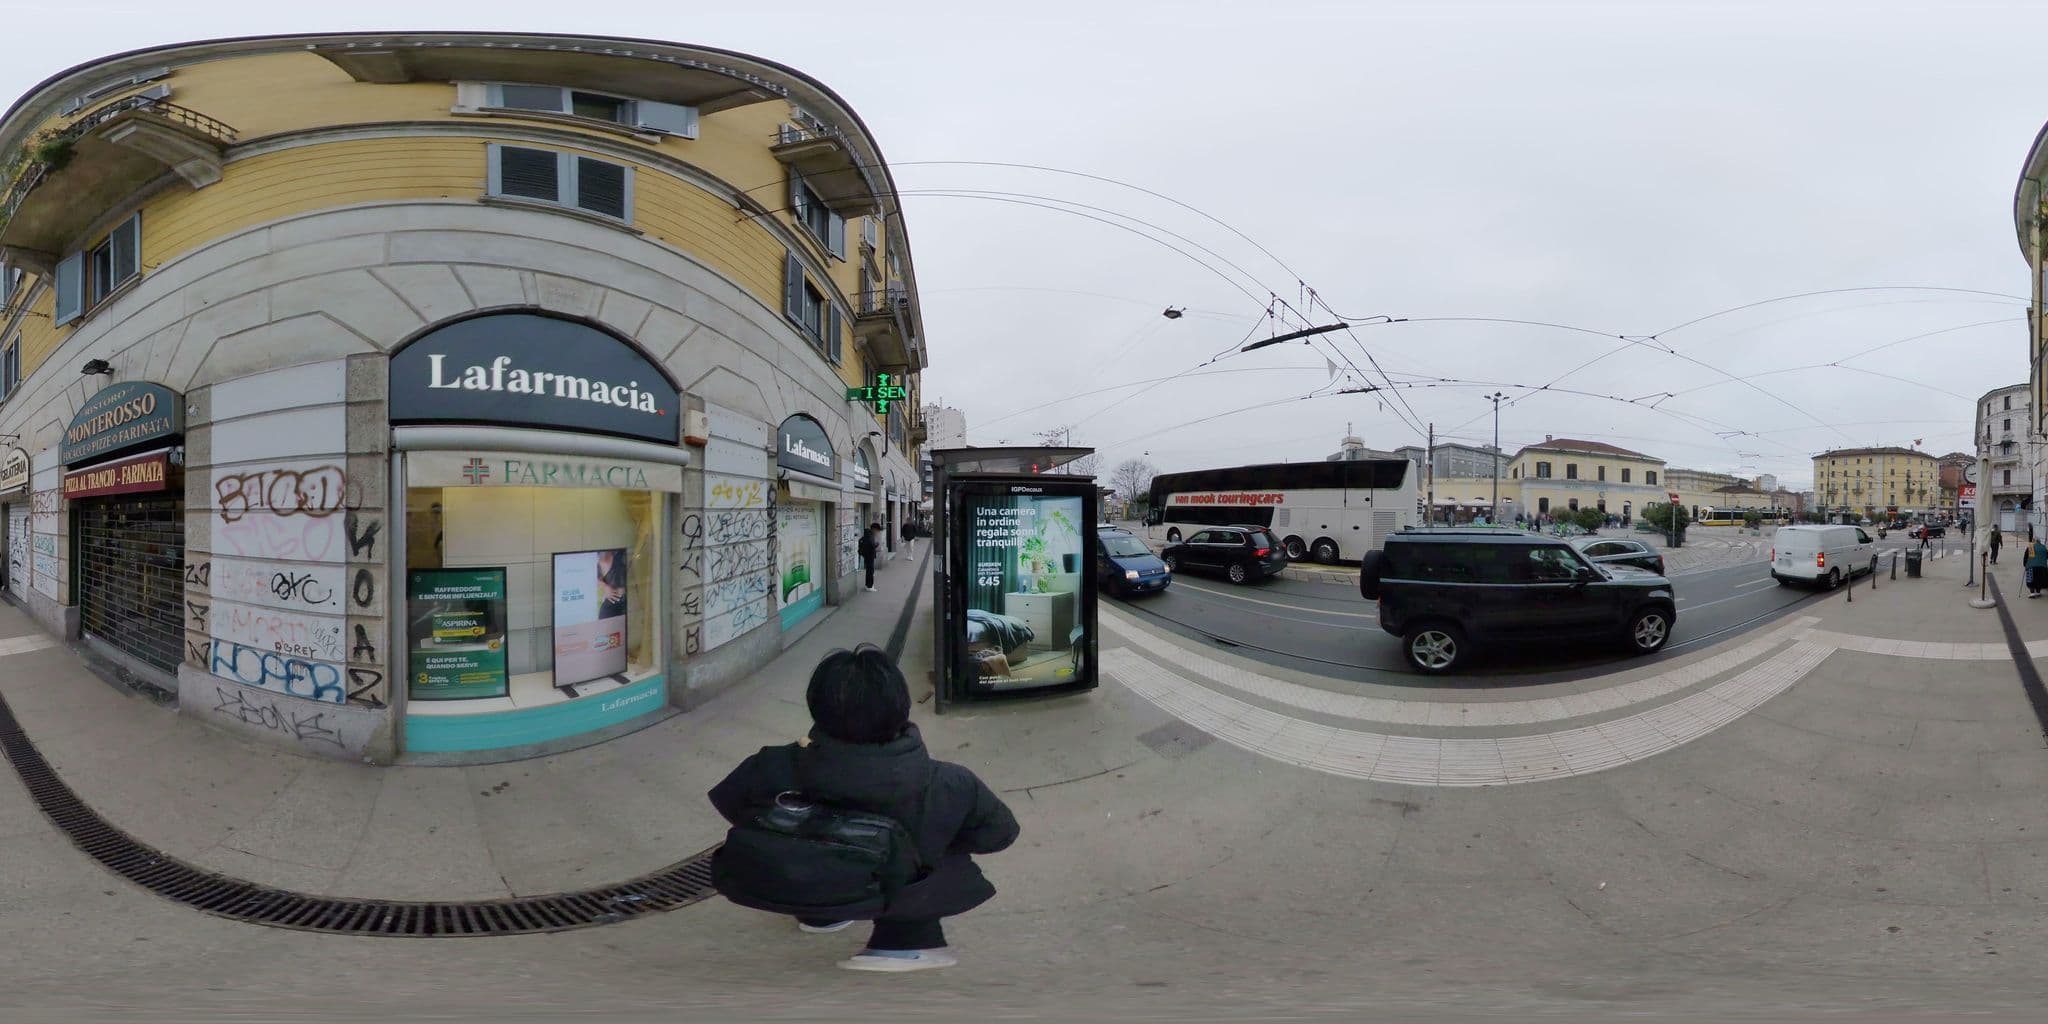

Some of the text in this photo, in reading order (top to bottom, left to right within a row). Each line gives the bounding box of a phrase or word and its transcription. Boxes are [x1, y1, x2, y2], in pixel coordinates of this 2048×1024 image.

[427, 354, 666, 417] Lafarmacia.
[68, 392, 156, 446] MONTEROSSO
[91, 436, 112, 454] PIZZE
[119, 417, 170, 443] FARINATA
[65, 476, 79, 493] PIZZA
[79, 475, 86, 490] AL
[87, 468, 116, 490] TRANCIO
[121, 461, 163, 485] FARINATA
[503, 460, 648, 488] FARMACIA
[1175, 492, 1284, 506] van mook touringcars
[976, 507, 1036, 516] Una camera
[976, 517, 1021, 526] in ordine
[976, 527, 1038, 538] regala sonni
[978, 576, 1000, 586] €45
[434, 585, 482, 593] RAFFREDDORE
[441, 619, 478, 627] ASPIRINA
[432, 656, 443, 664] QUI
[602, 686, 658, 713] Lafarmacia
